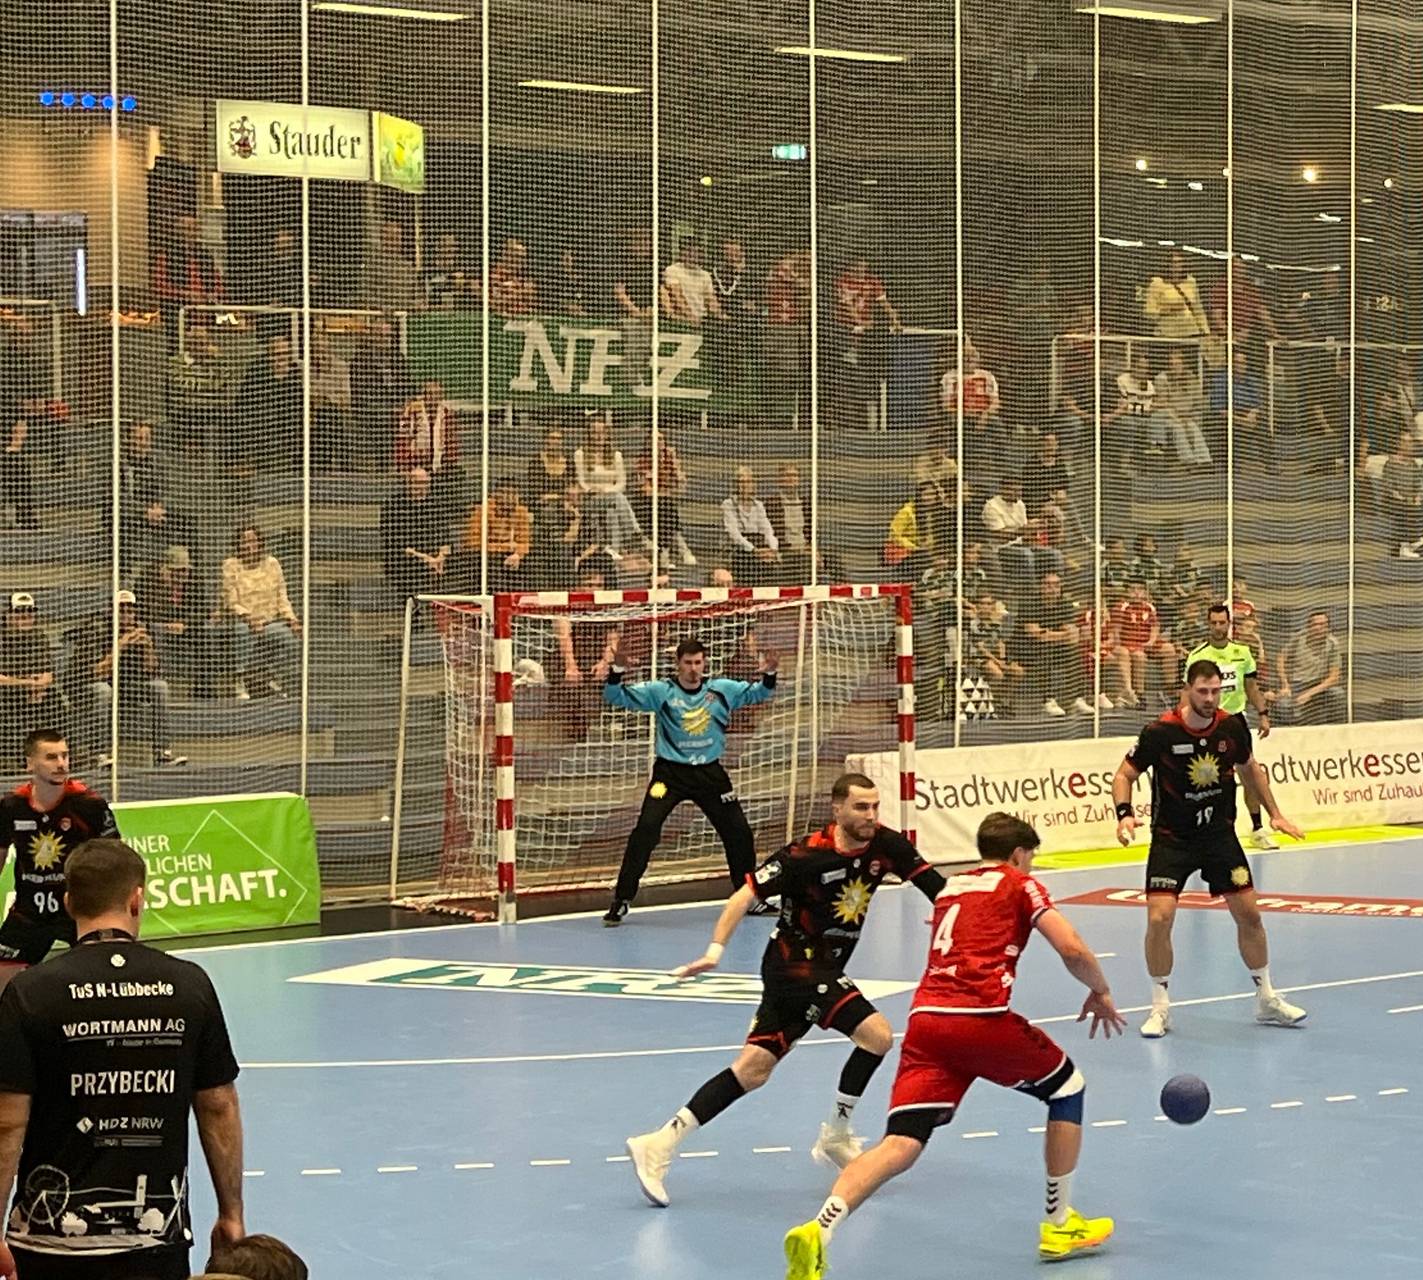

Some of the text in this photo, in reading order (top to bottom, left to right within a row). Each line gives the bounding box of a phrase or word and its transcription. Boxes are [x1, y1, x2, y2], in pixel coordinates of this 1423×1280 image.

[269, 121, 361, 159] Stauder
[915, 768, 1152, 810] Stadtwerkessn
[1312, 782, 1422, 805] Wir sind Zuhau
[1044, 807, 1078, 827] sind
[121, 835, 170, 853] INER
[146, 853, 212, 875] LICHEN
[144, 869, 287, 909] SCHAFT.
[33, 892, 59, 913] 96
[933, 903, 961, 956] 4
[69, 983, 94, 999] TuS
[62, 1018, 186, 1037] WORTMANN AG
[71, 1069, 175, 1096] PRZYBECKI
[131, 1117, 164, 1130] NRW
